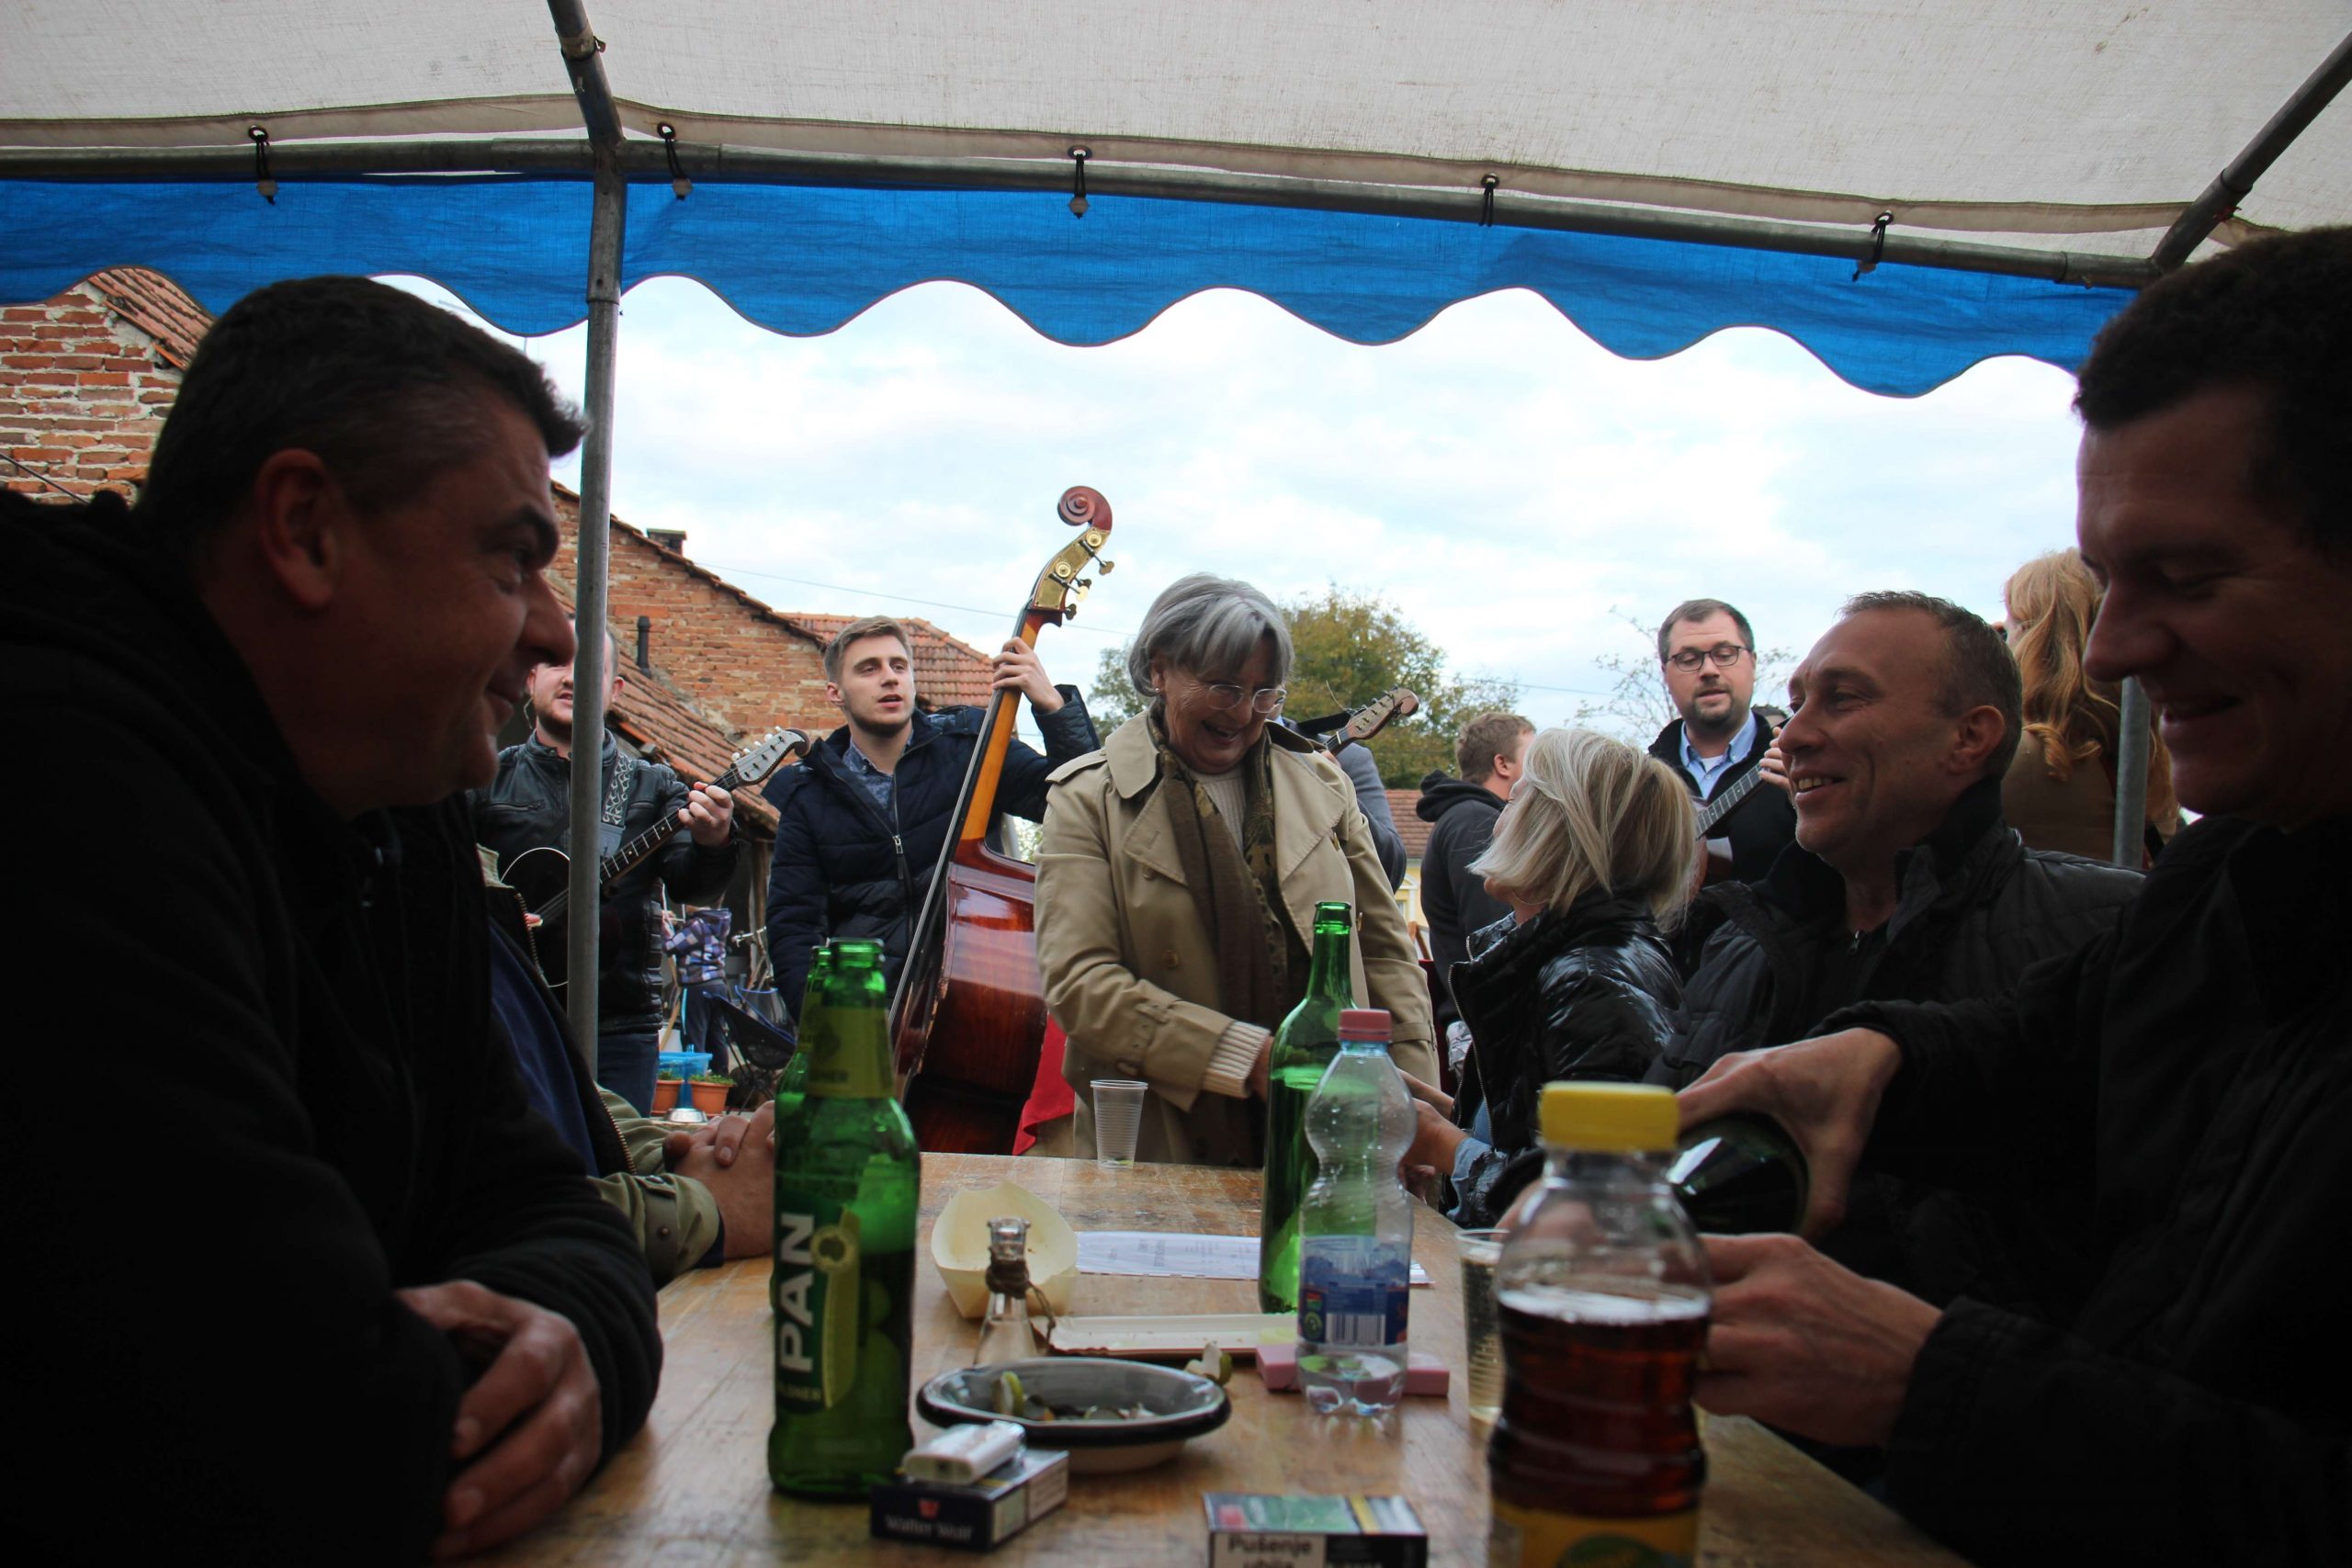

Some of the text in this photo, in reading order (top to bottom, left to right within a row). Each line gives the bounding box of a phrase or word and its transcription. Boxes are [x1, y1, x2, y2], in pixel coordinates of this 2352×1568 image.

[780, 1213, 815, 1372] PAN
[885, 1514, 973, 1541] Walter Wolf
